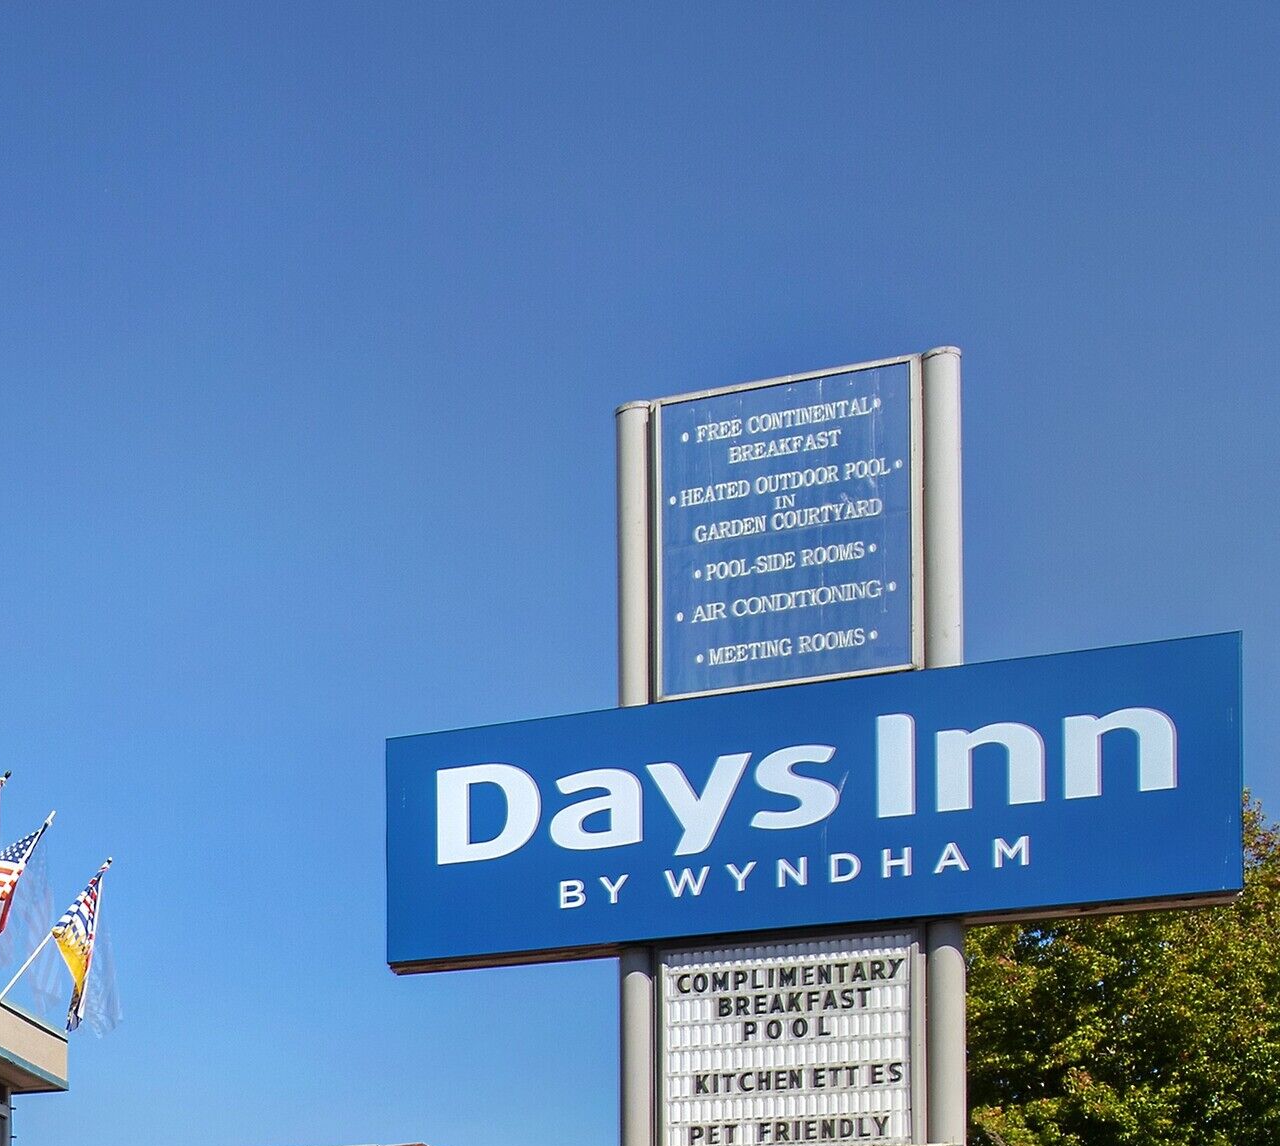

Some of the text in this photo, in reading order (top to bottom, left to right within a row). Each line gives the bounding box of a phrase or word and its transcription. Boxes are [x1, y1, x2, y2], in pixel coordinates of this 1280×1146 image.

[697, 397, 873, 444] FREE CONTINENTAL
[728, 429, 842, 464] BREAKFAST
[680, 458, 891, 507] HEATED OUTDOOR POOL
[775, 494, 796, 510] IN
[694, 498, 883, 543] GARDEN COURTYARD
[705, 541, 866, 581] POOL-SIDE ROOMS
[691, 579, 883, 623] AIR CONDITIONING
[708, 627, 866, 666] MEETING ROOMS
[436, 707, 1178, 867] Days Inn
[558, 834, 1032, 910] BY WYNDHAM
[677, 958, 905, 994] COMPLIMENTARY
[718, 987, 872, 1018] BREAKFAST
[743, 1016, 831, 1041] POOL
[690, 1115, 890, 1145] PET FRIENDLY
